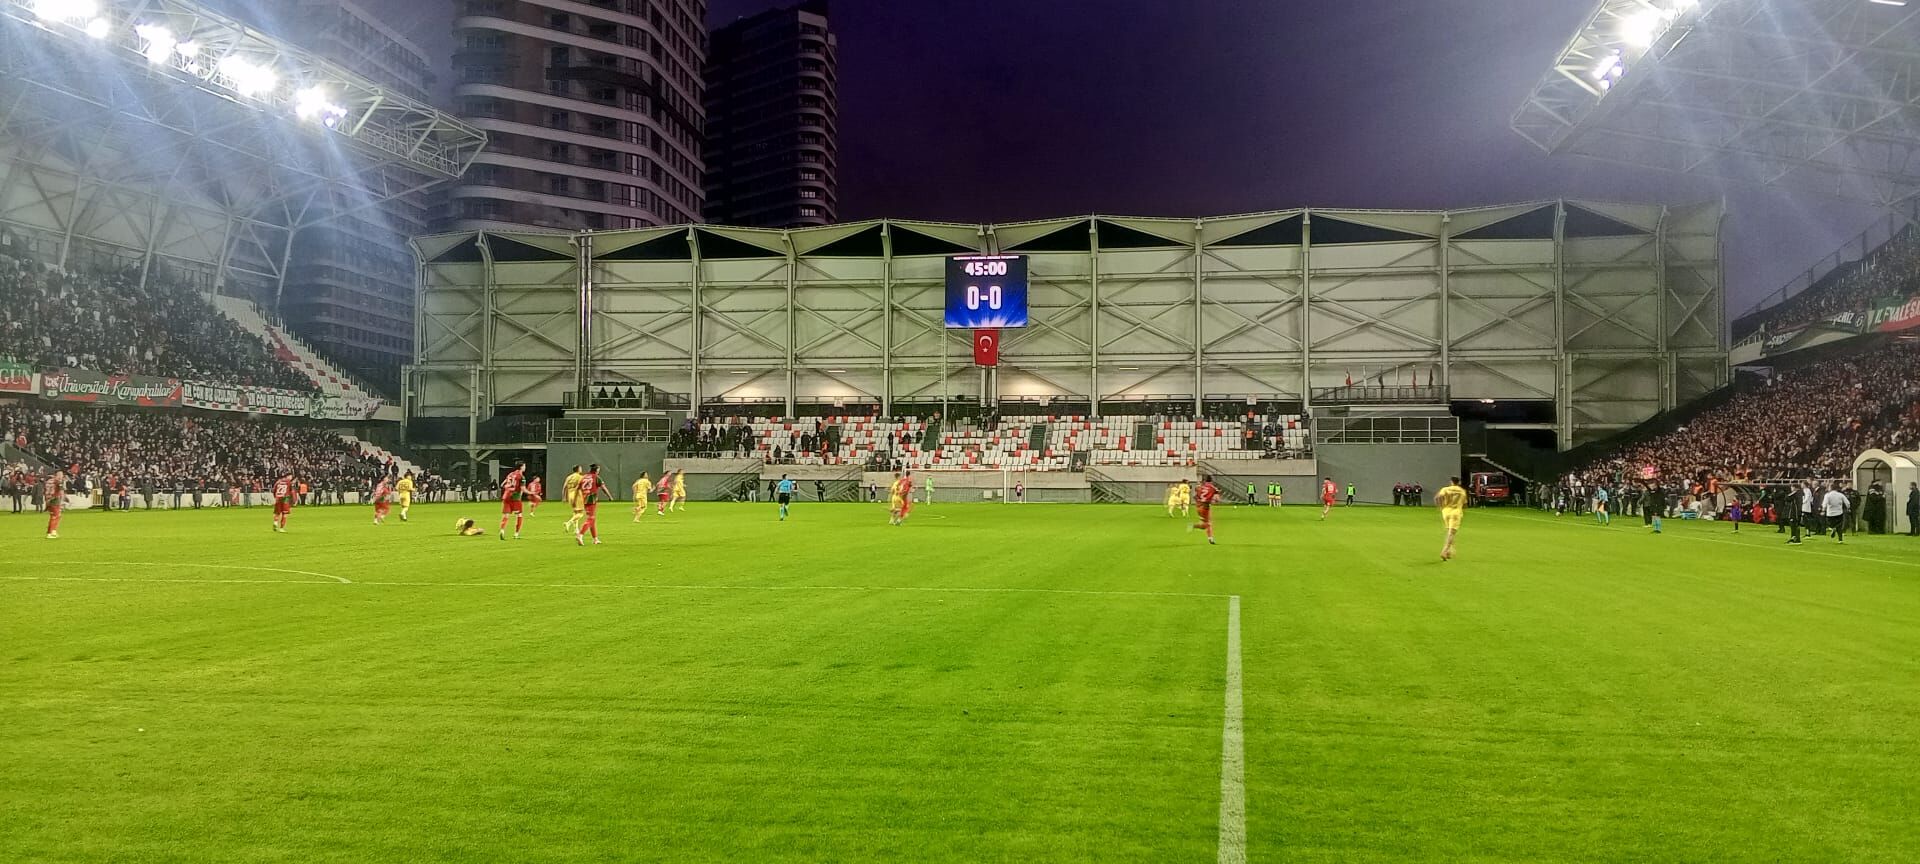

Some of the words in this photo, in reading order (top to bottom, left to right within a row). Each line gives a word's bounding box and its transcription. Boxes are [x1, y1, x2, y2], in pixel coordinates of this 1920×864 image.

[965, 261, 1007, 276] 45:00
[967, 286, 1002, 310] 0-0
[60, 374, 111, 396] Üniversiteli
[1200, 489, 1209, 502] 2
